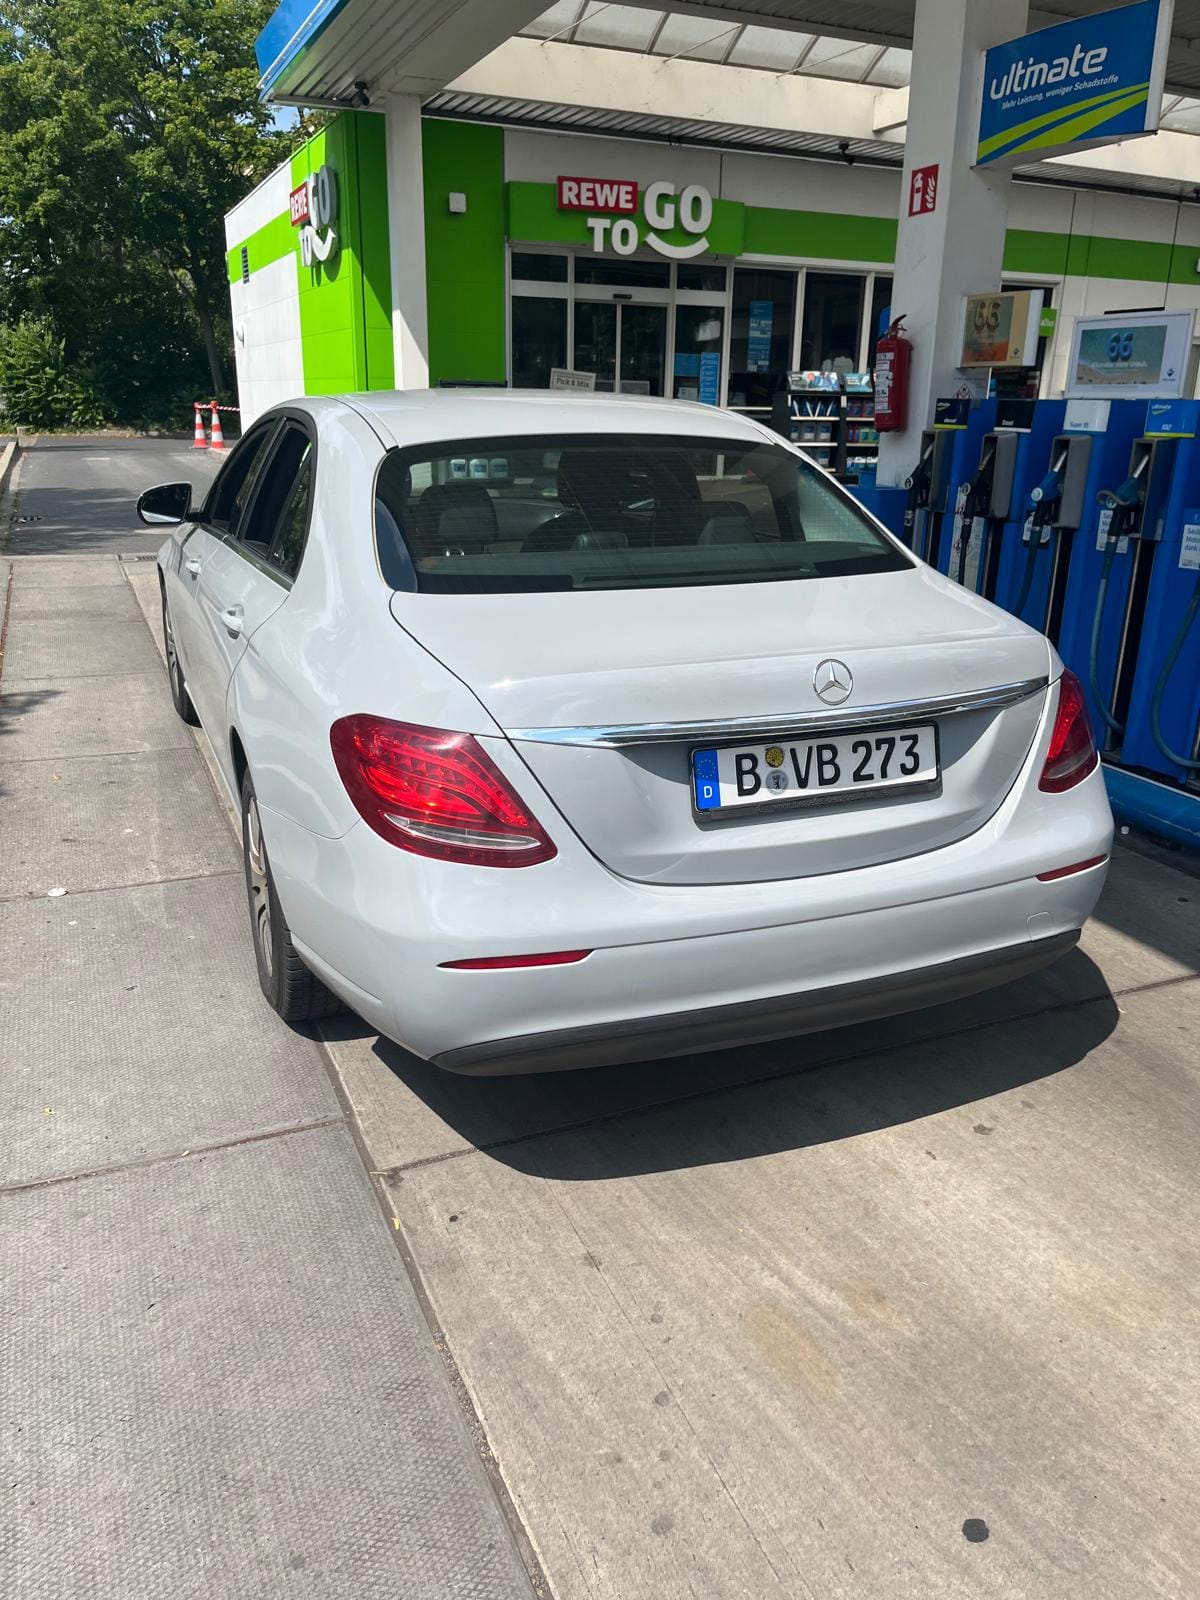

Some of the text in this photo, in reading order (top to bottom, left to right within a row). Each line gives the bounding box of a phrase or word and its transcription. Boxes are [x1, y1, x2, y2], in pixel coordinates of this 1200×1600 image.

[990, 43, 1108, 101] ultimate
[1001, 74, 1119, 110] Mehr Leistung, weniger Schadstoffe
[290, 185, 308, 223] REWE
[308, 165, 334, 230] GO
[562, 181, 634, 209] REWE
[644, 181, 713, 234] GO
[298, 225, 313, 267] TO
[587, 217, 639, 256] TO
[1107, 332, 1134, 362] 66
[556, 377, 570, 387] Pick
[576, 379, 590, 388] Mix
[734, 734, 920, 798] B VB 273
[703, 785, 713, 798] D
